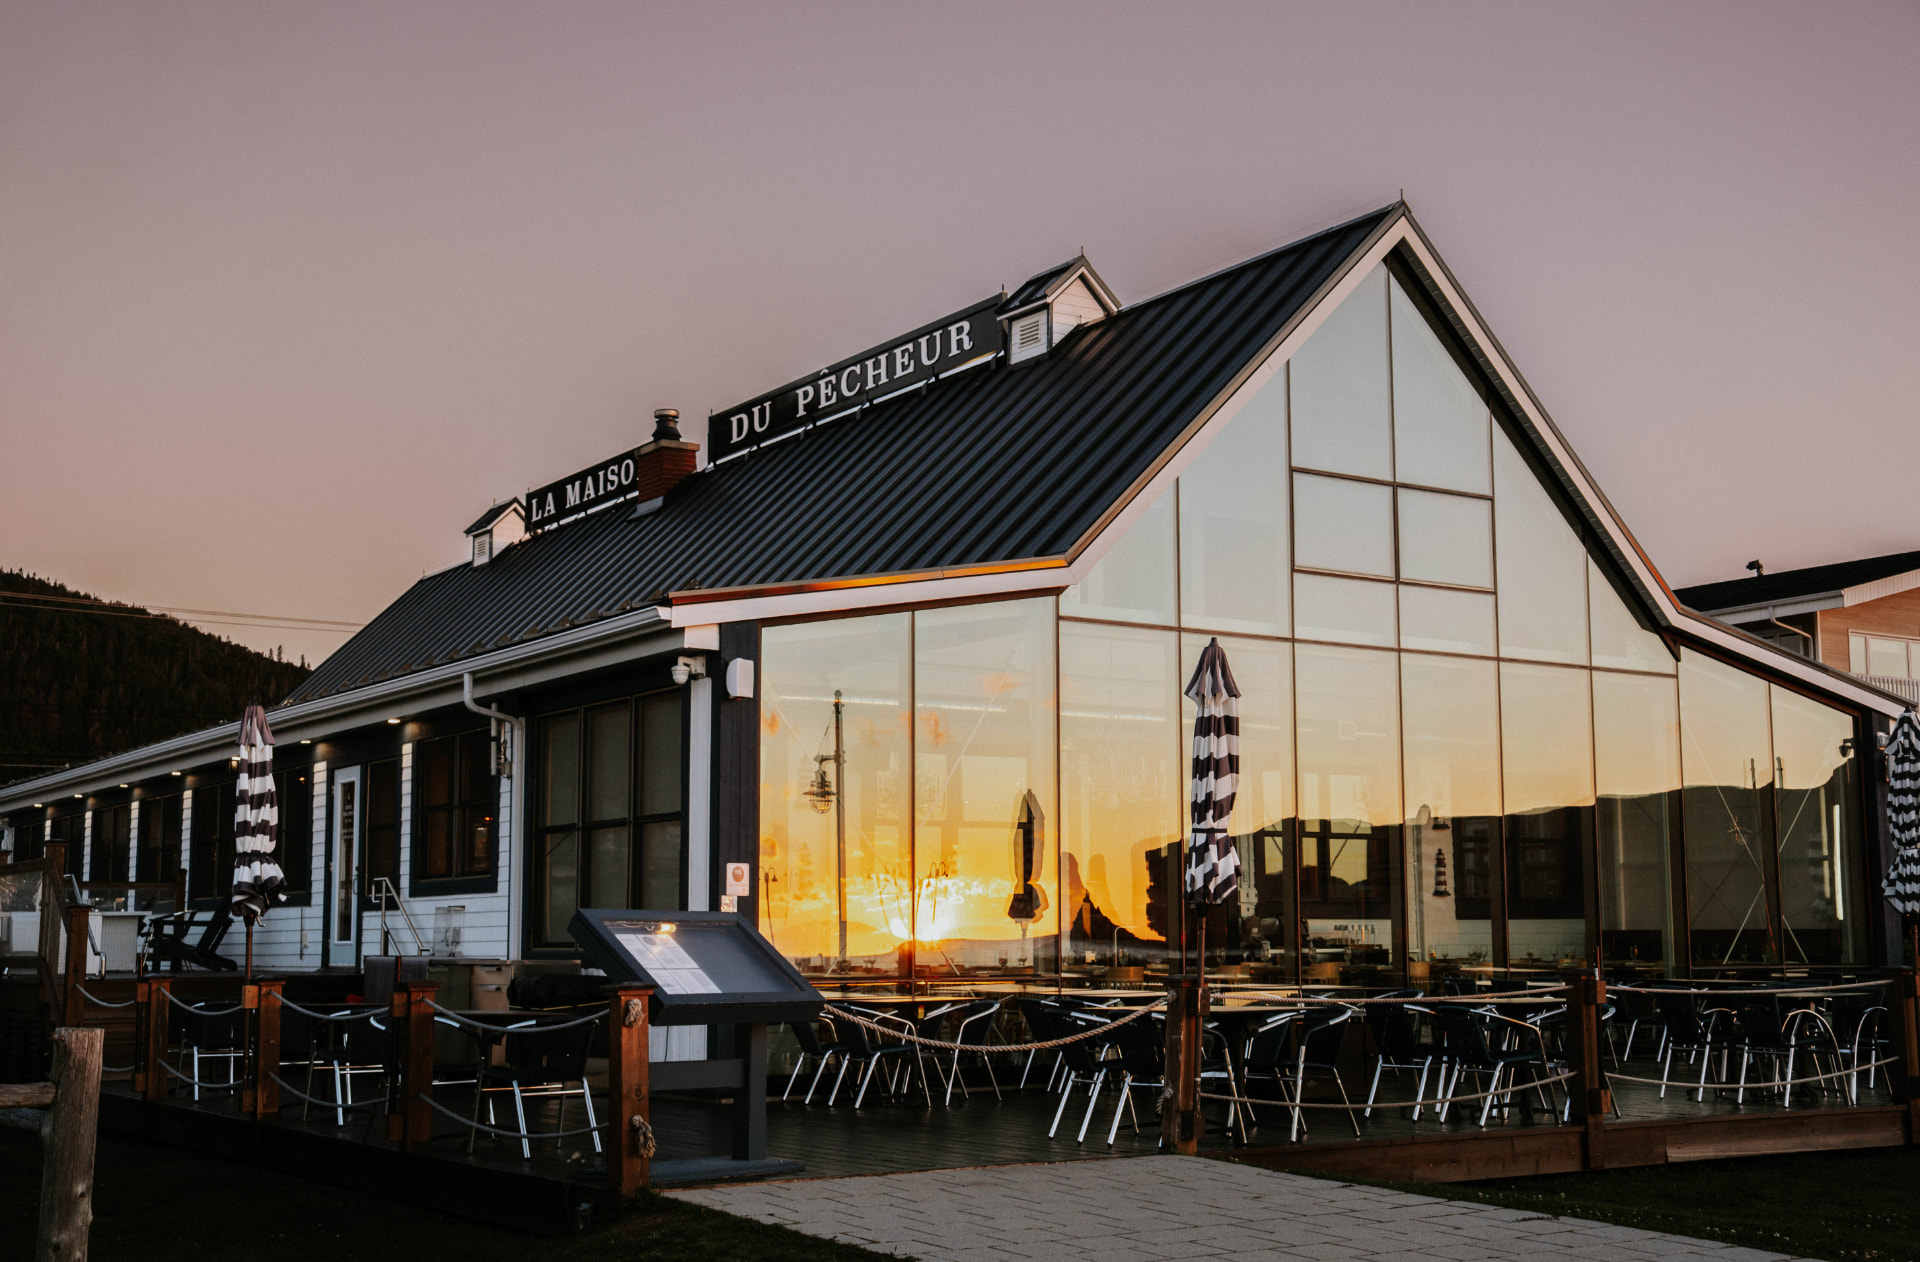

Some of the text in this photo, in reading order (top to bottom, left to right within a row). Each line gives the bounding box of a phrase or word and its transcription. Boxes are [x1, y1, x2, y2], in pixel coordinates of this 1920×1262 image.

[730, 320, 974, 444] DU PÊCHEUR
[531, 459, 638, 523] LA MAISO
